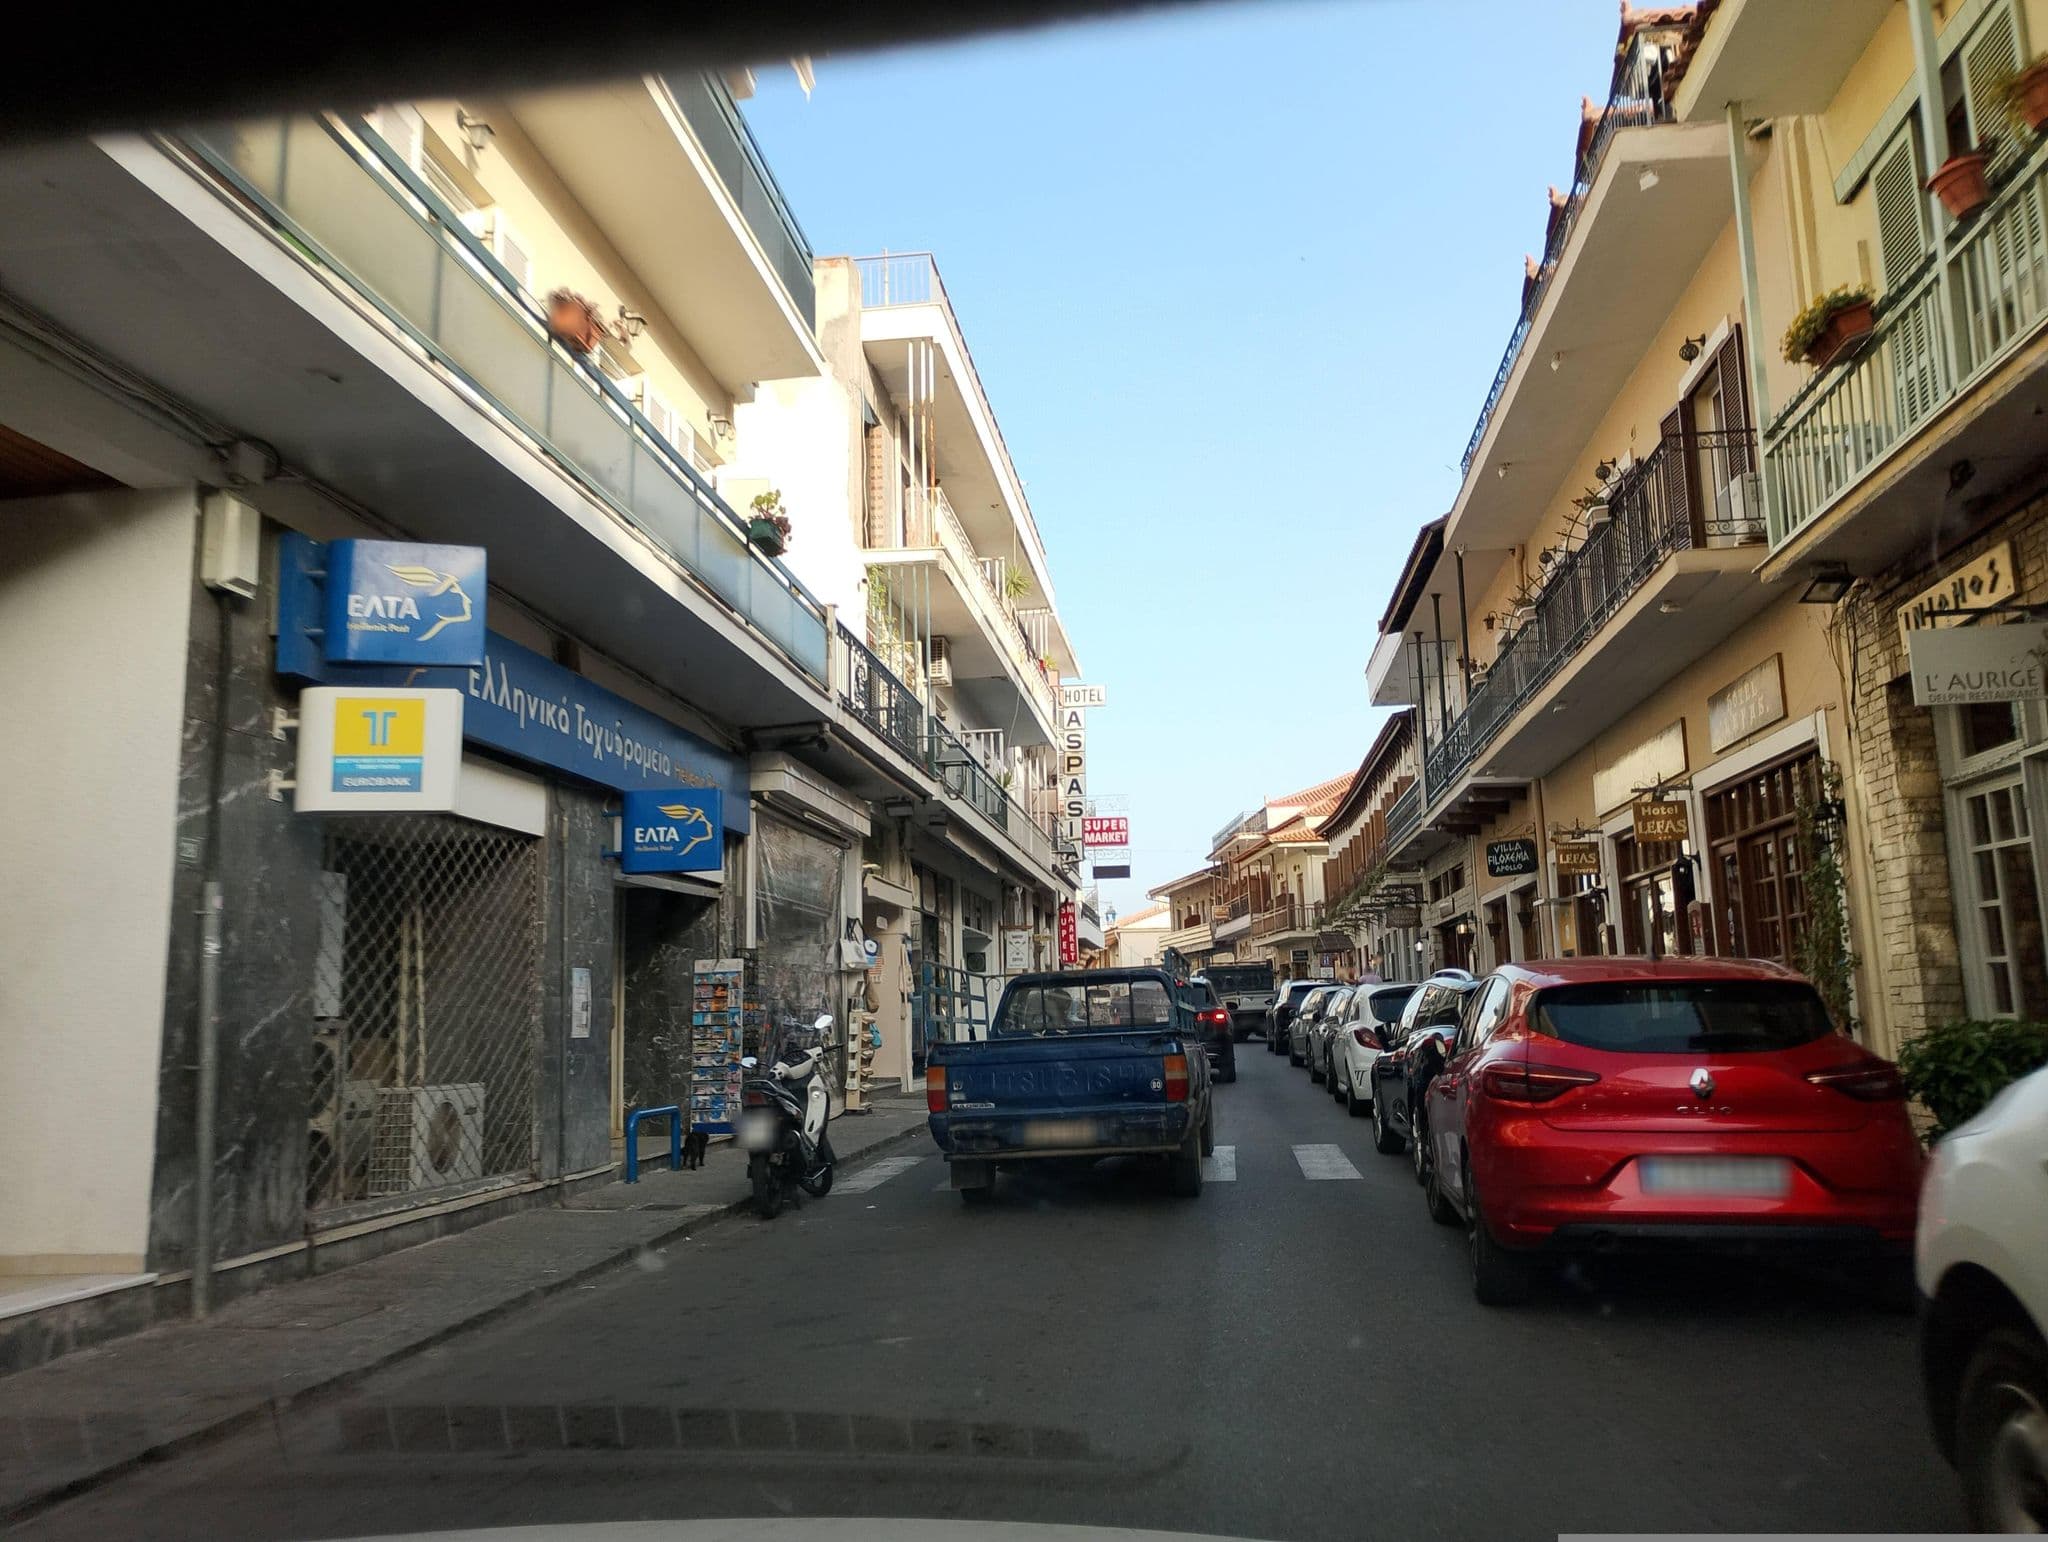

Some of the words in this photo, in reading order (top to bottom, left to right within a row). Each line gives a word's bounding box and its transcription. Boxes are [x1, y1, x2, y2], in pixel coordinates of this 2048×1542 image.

[348, 594, 421, 620] ΕΛΤΑ
[1948, 668, 2039, 691] AURIGE
[1064, 687, 1103, 704] HOTEL
[1641, 804, 1678, 816] Hotel
[1084, 819, 1127, 831] SUPER
[1637, 817, 1687, 835] LEFAS
[635, 826, 680, 843] ΕΛΤΑ
[1084, 831, 1128, 844] MARKET
[1493, 842, 1522, 854] VILLA
[1559, 852, 1597, 865] LEFAS
[1495, 863, 1523, 873] APOLLO
